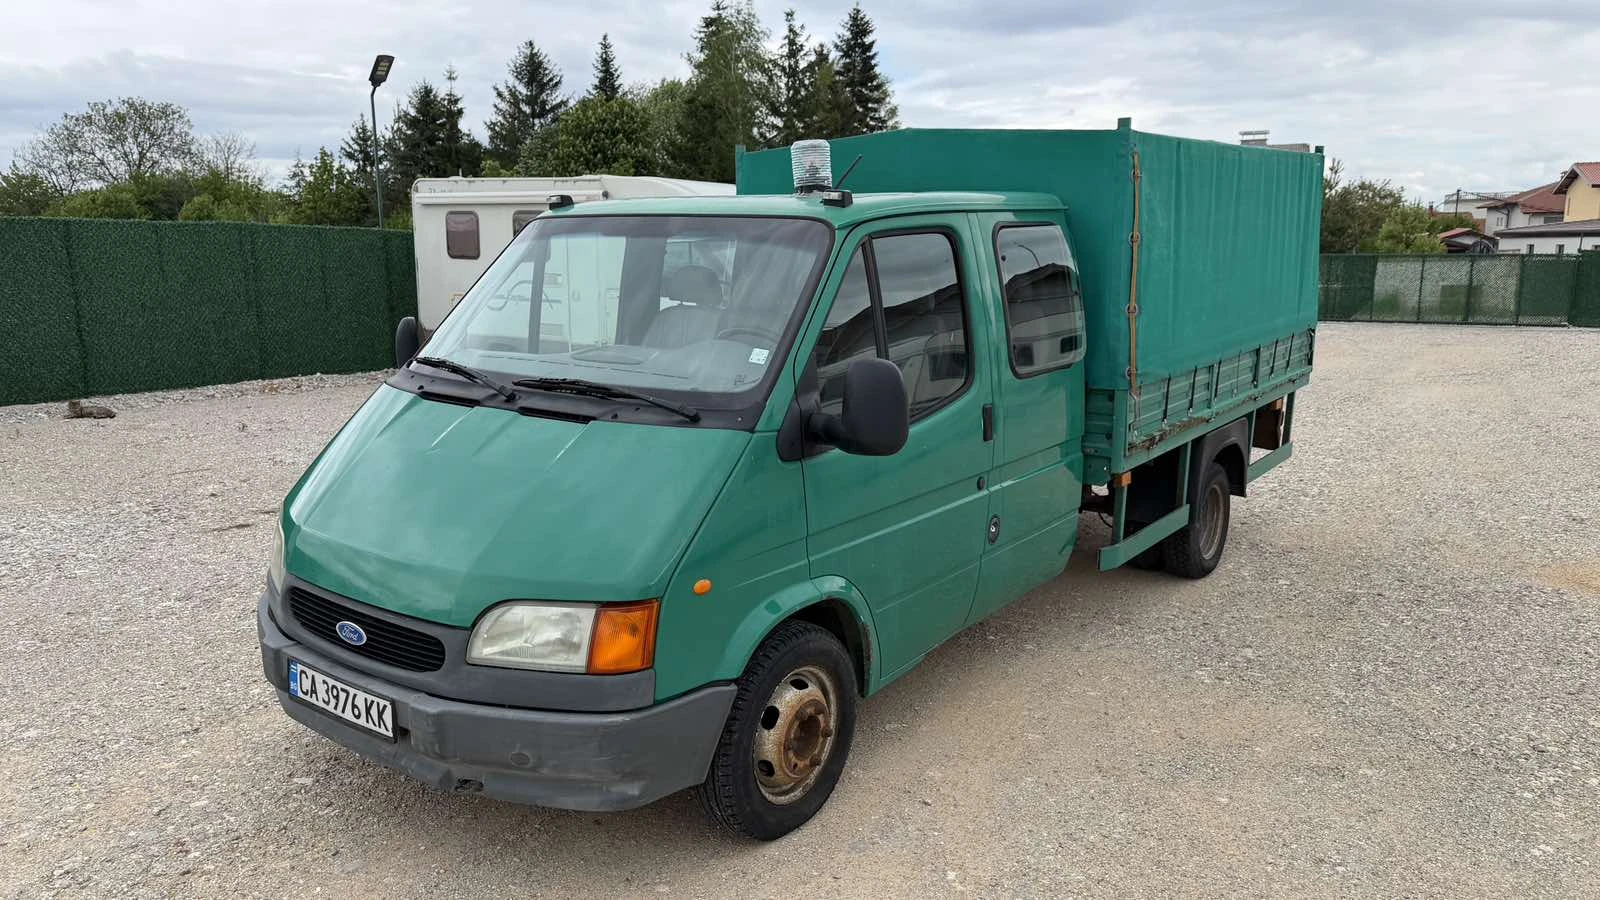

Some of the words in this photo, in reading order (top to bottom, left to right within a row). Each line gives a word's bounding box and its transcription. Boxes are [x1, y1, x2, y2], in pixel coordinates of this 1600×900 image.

[341, 625, 359, 641] Ford
[299, 669, 319, 702] CA
[322, 679, 361, 720] 3976
[364, 697, 390, 732] KK
